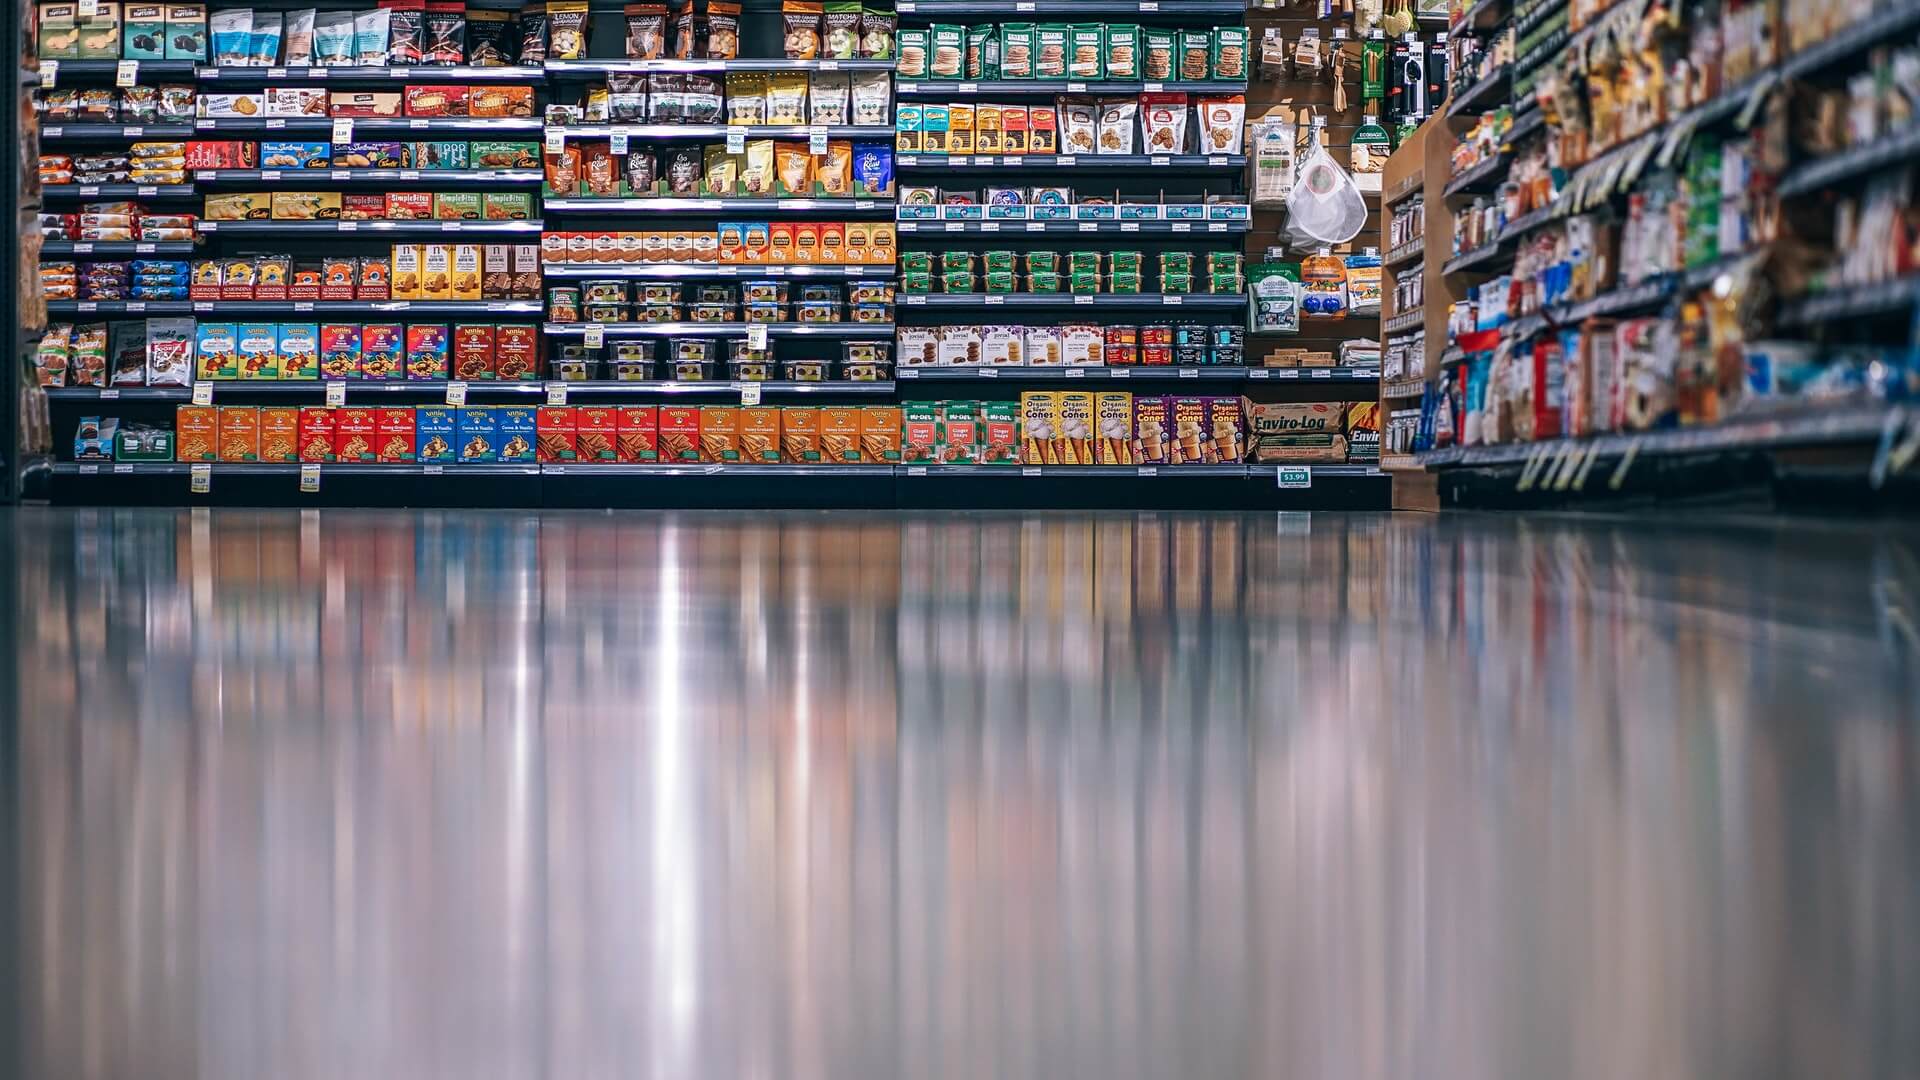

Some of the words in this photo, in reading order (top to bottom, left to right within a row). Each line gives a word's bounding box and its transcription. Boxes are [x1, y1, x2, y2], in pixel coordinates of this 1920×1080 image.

[392, 194, 429, 203] SimpleBites
[1025, 410, 1053, 418] Cones
[1062, 410, 1089, 418] Cones
[1100, 410, 1127, 418] Cones
[1256, 416, 1325, 430] Enviro-Log
